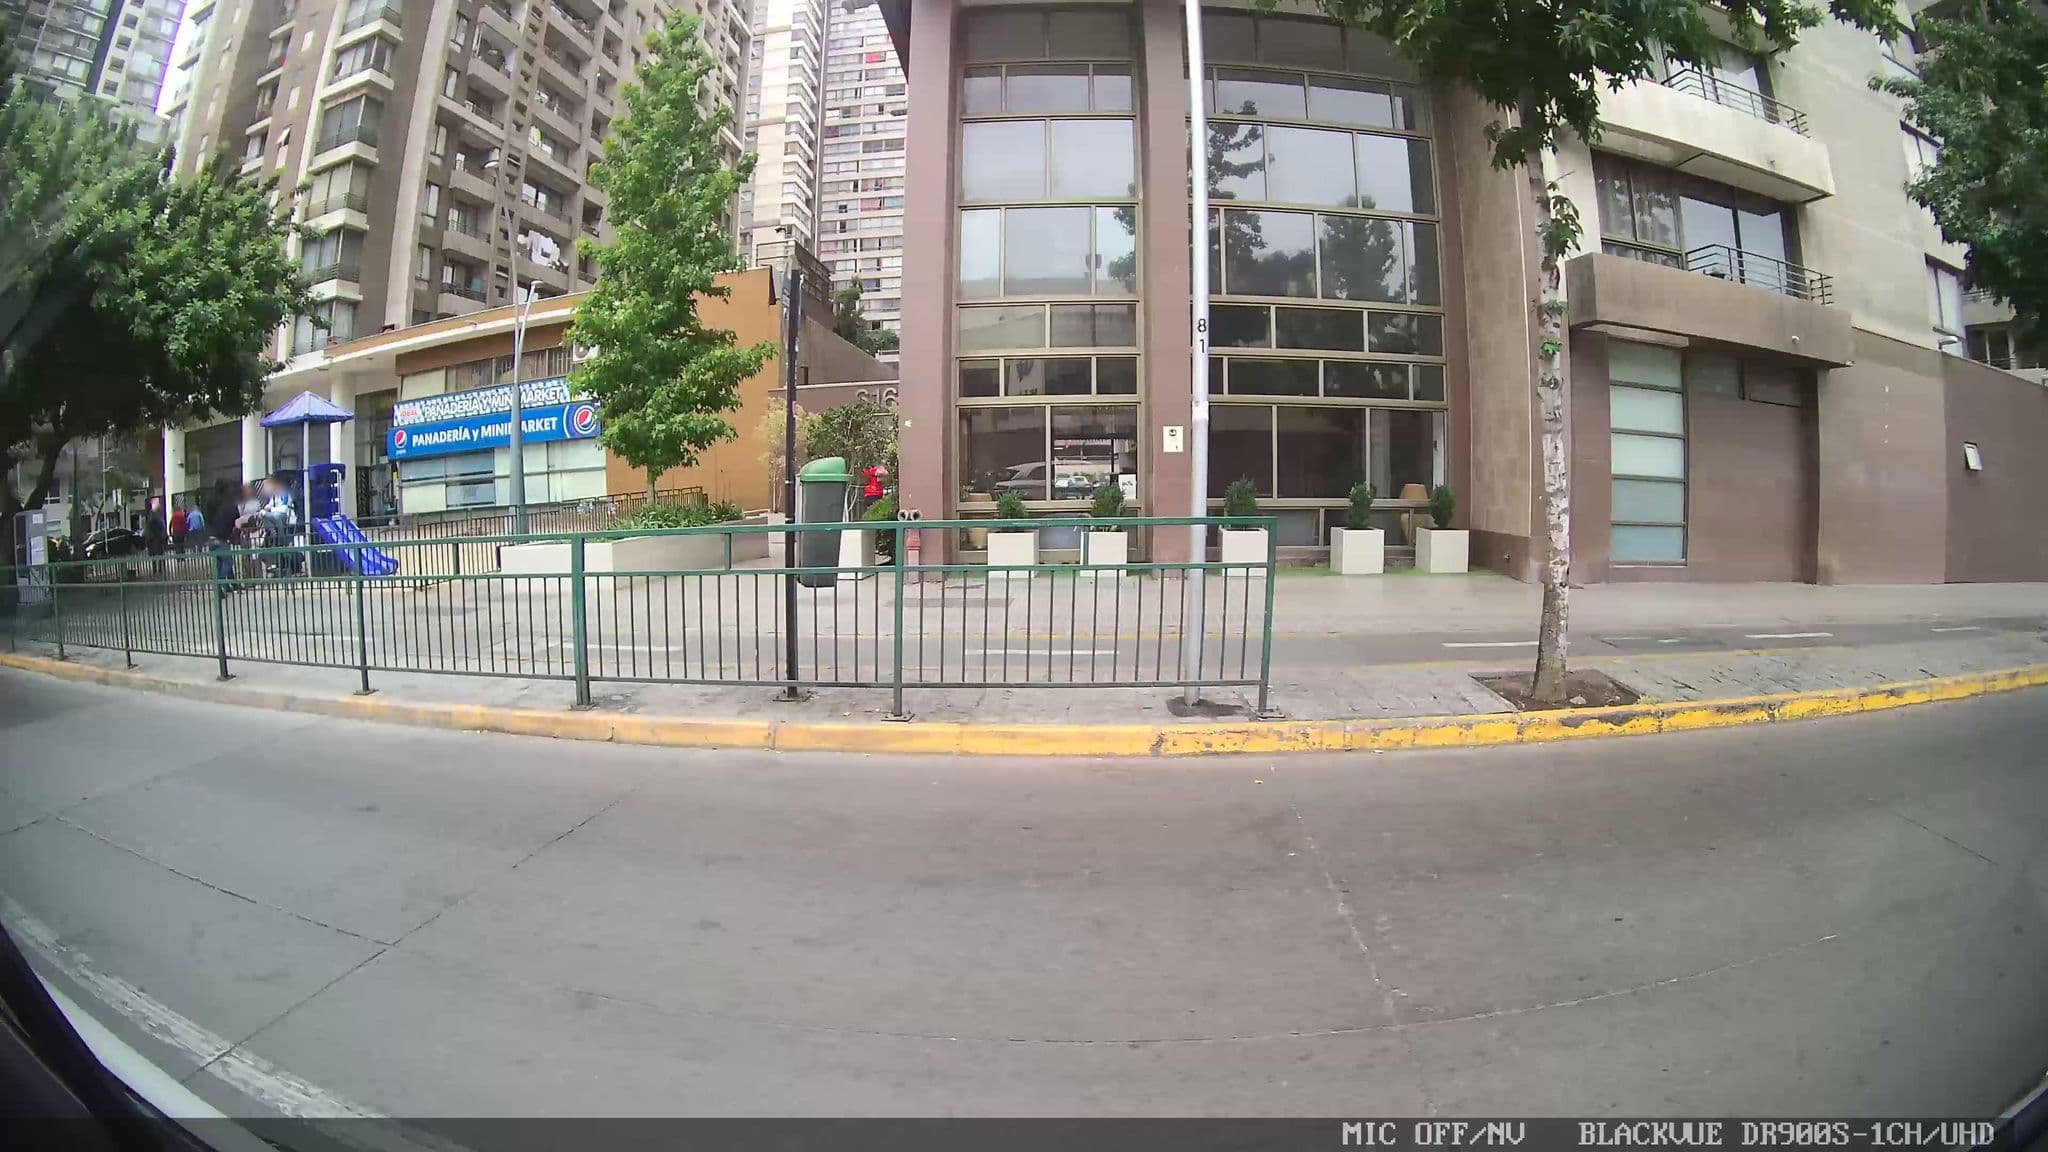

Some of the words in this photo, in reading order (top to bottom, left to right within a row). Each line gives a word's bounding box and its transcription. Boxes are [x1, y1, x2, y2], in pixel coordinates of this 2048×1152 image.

[481, 396, 490, 410] Y
[491, 386, 562, 408] MINMARKET
[412, 426, 471, 447] PANADERÍA
[472, 430, 480, 441] y
